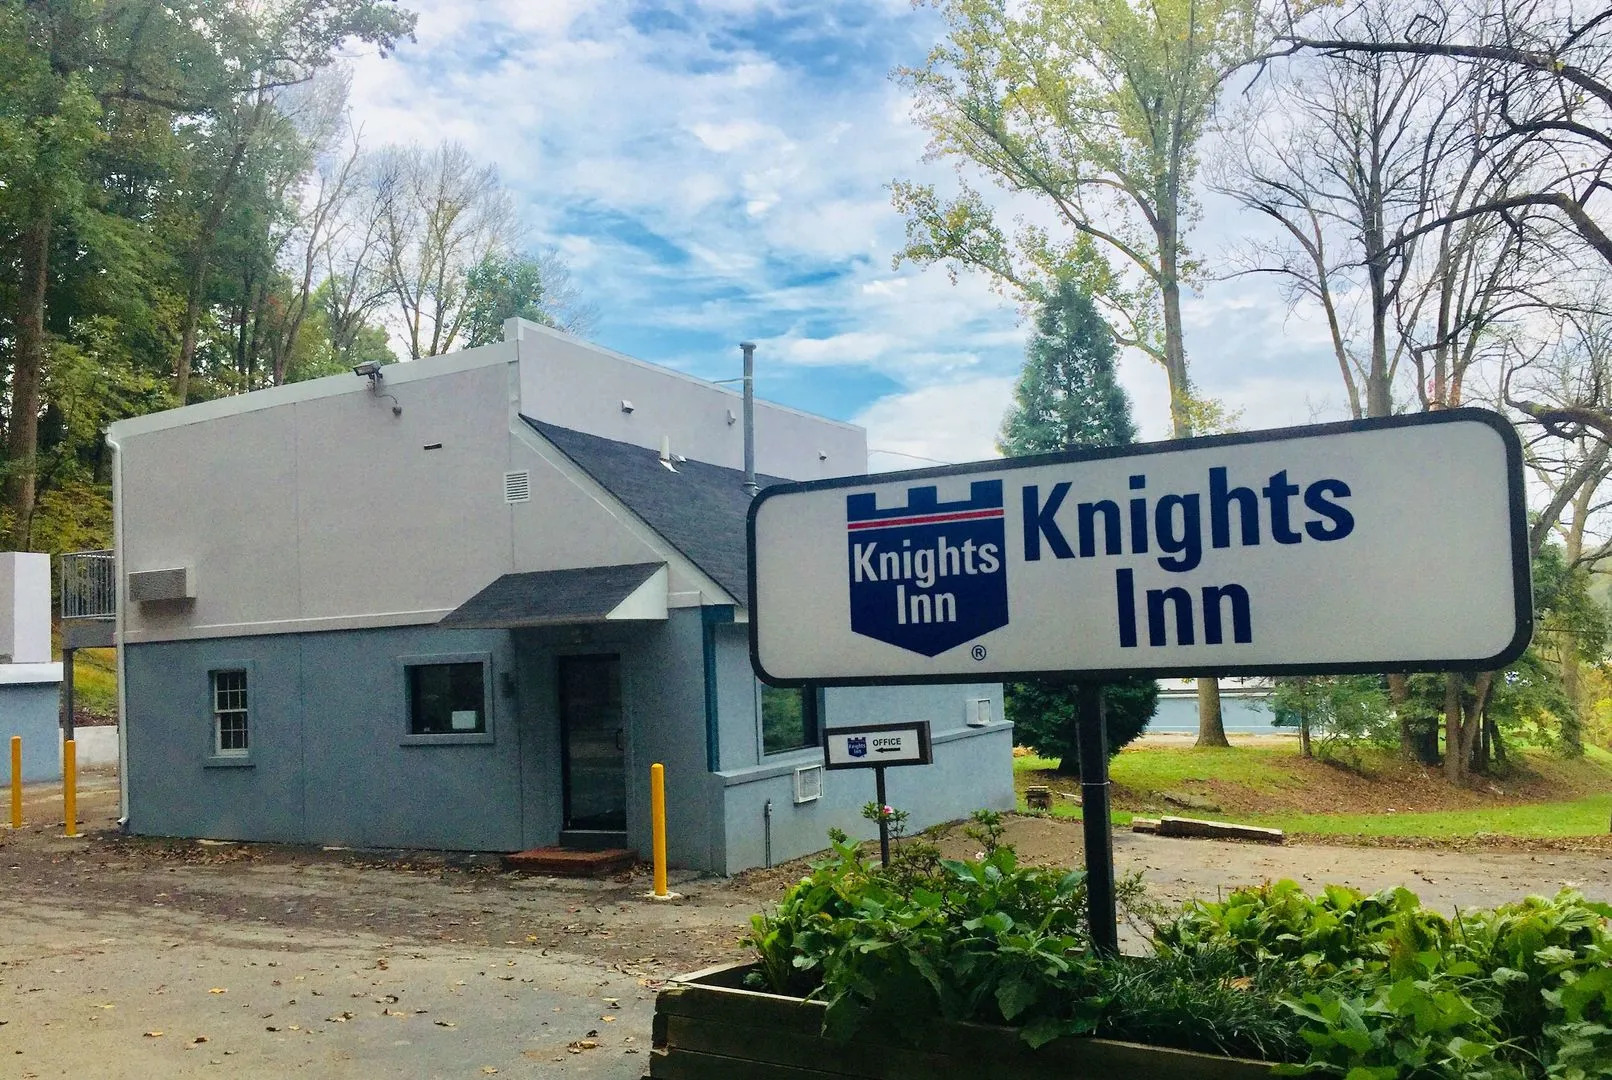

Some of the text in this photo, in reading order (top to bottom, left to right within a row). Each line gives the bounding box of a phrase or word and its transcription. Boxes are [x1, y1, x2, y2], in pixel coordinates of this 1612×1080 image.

[1022, 466, 1355, 573] Knights
[852, 536, 1000, 588] Knights
[896, 585, 957, 625] Inn
[1116, 566, 1253, 648] Inn
[872, 738, 902, 747] OFFICE
